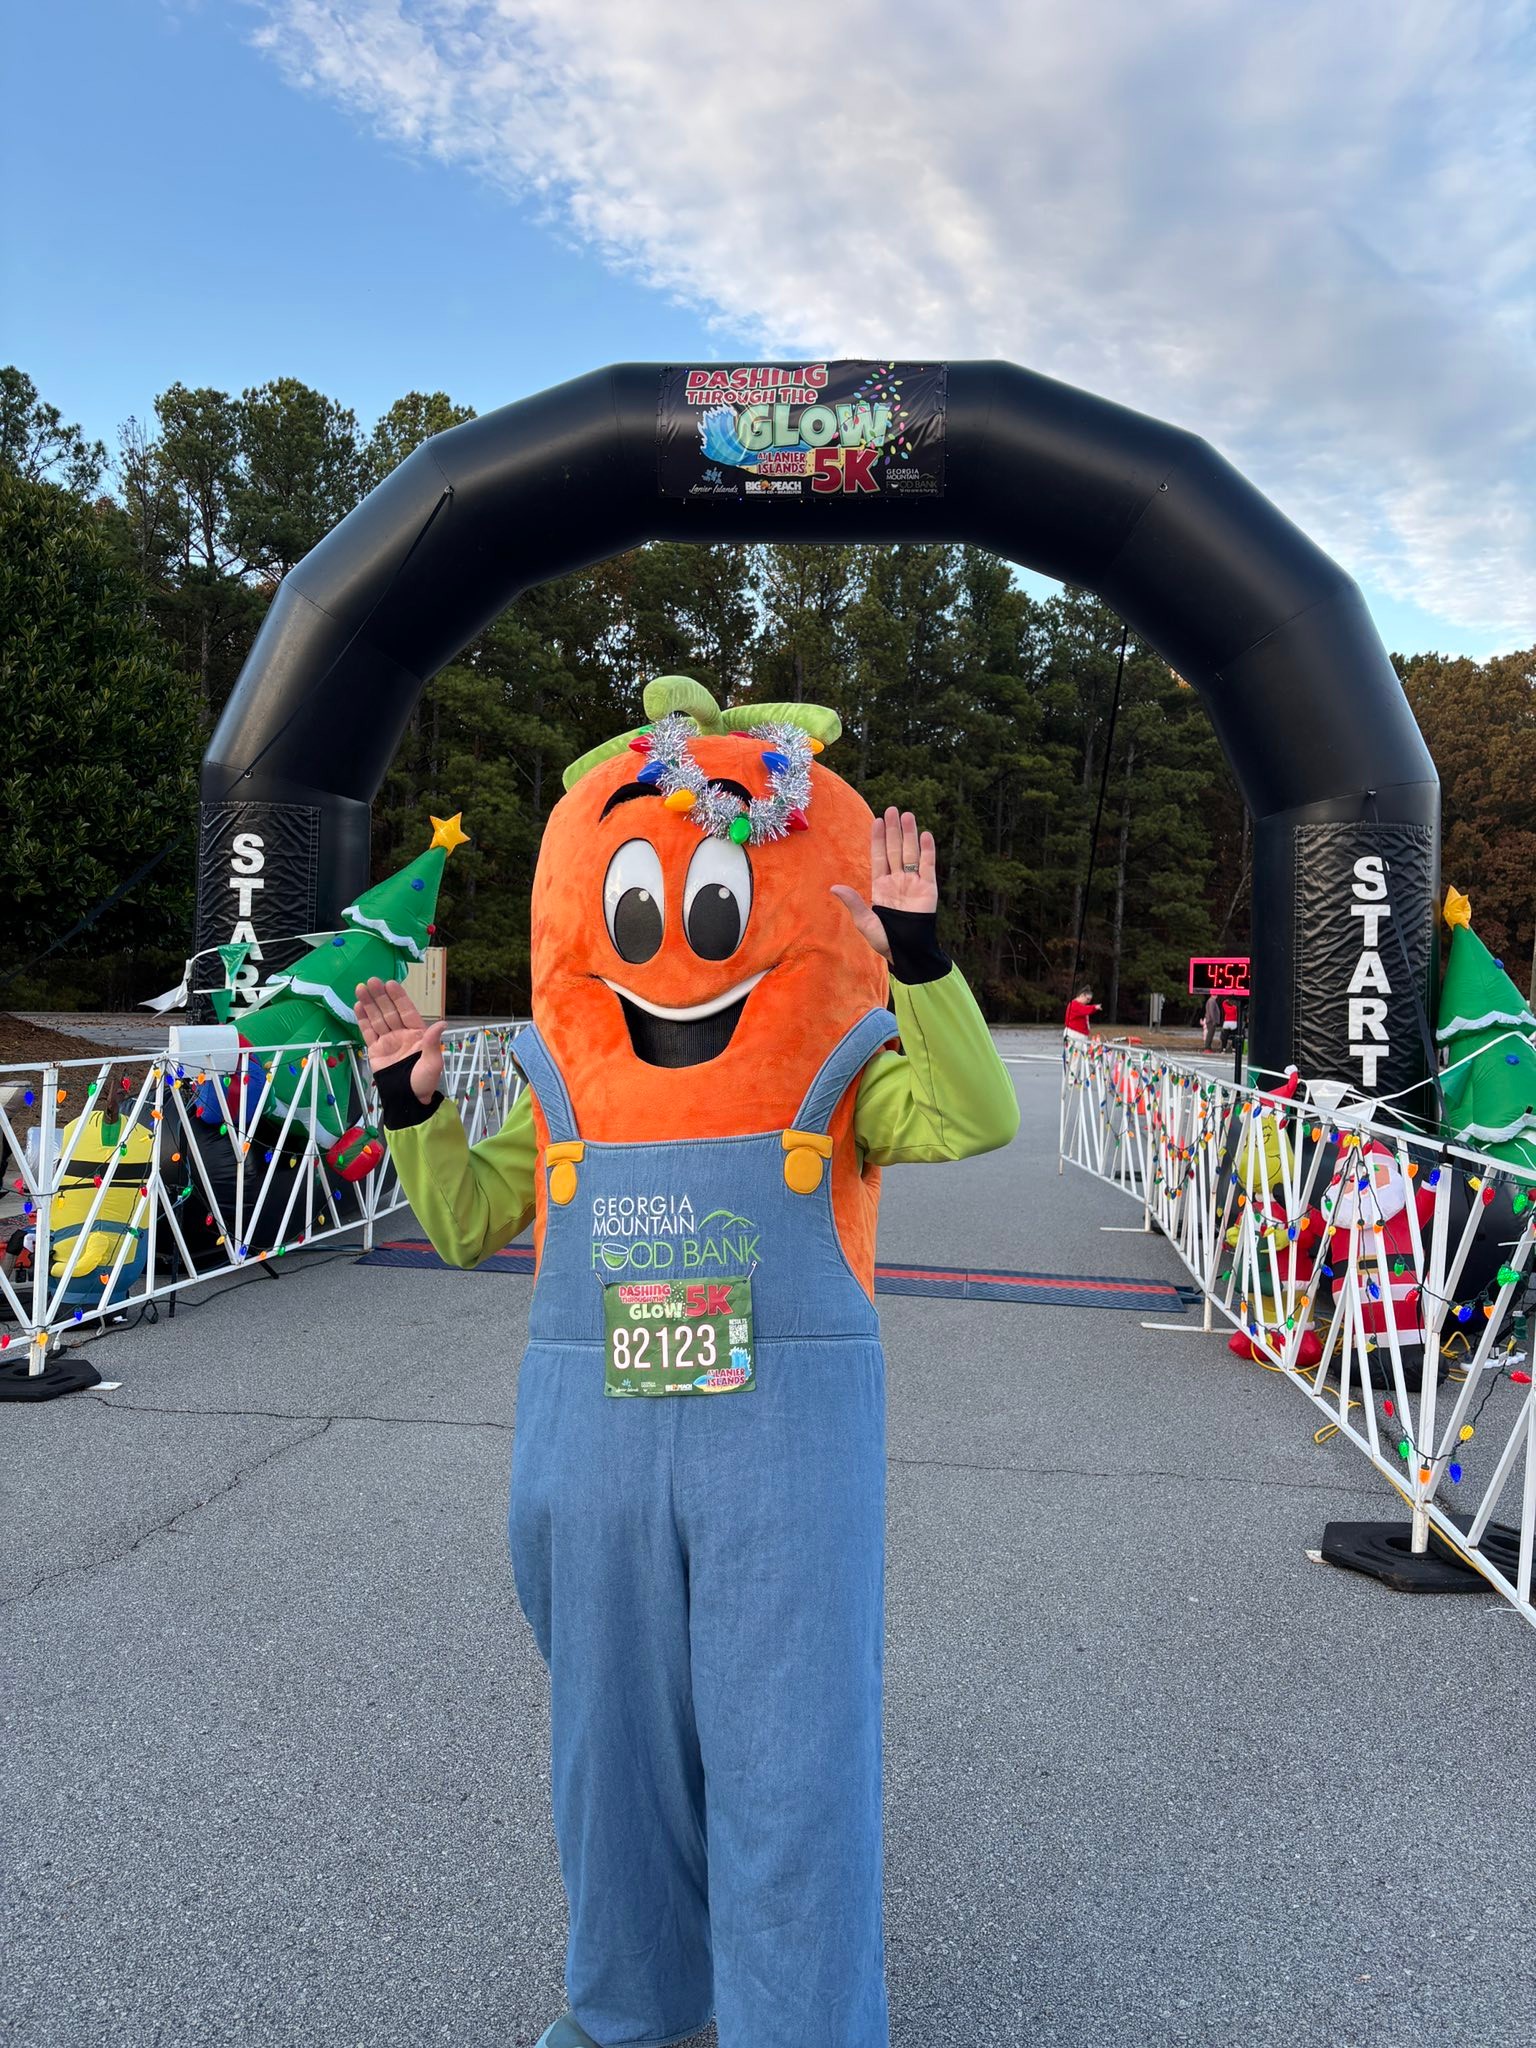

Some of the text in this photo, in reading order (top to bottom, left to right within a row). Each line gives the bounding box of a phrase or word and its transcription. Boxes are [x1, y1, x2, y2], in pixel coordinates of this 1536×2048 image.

[686, 389, 775, 405] THROUGH
[736, 402, 889, 450] GLOW
[768, 452, 806, 463] LANIER
[757, 463, 806, 474] ISLANDS
[811, 447, 881, 493] 5K
[745, 481, 802, 491] BIG PEACH
[1346, 856, 1392, 1087] START
[593, 1195, 693, 1216] GEORGIA
[592, 1215, 695, 1236] MOUNTAIN
[684, 1235, 762, 1267] BANK
[629, 1303, 682, 1320] GLOW
[686, 1285, 733, 1317] 5K
[613, 1324, 716, 1369] 82123
[707, 1377, 745, 1386] ISLANDS
[715, 1368, 745, 1377] LANIER
